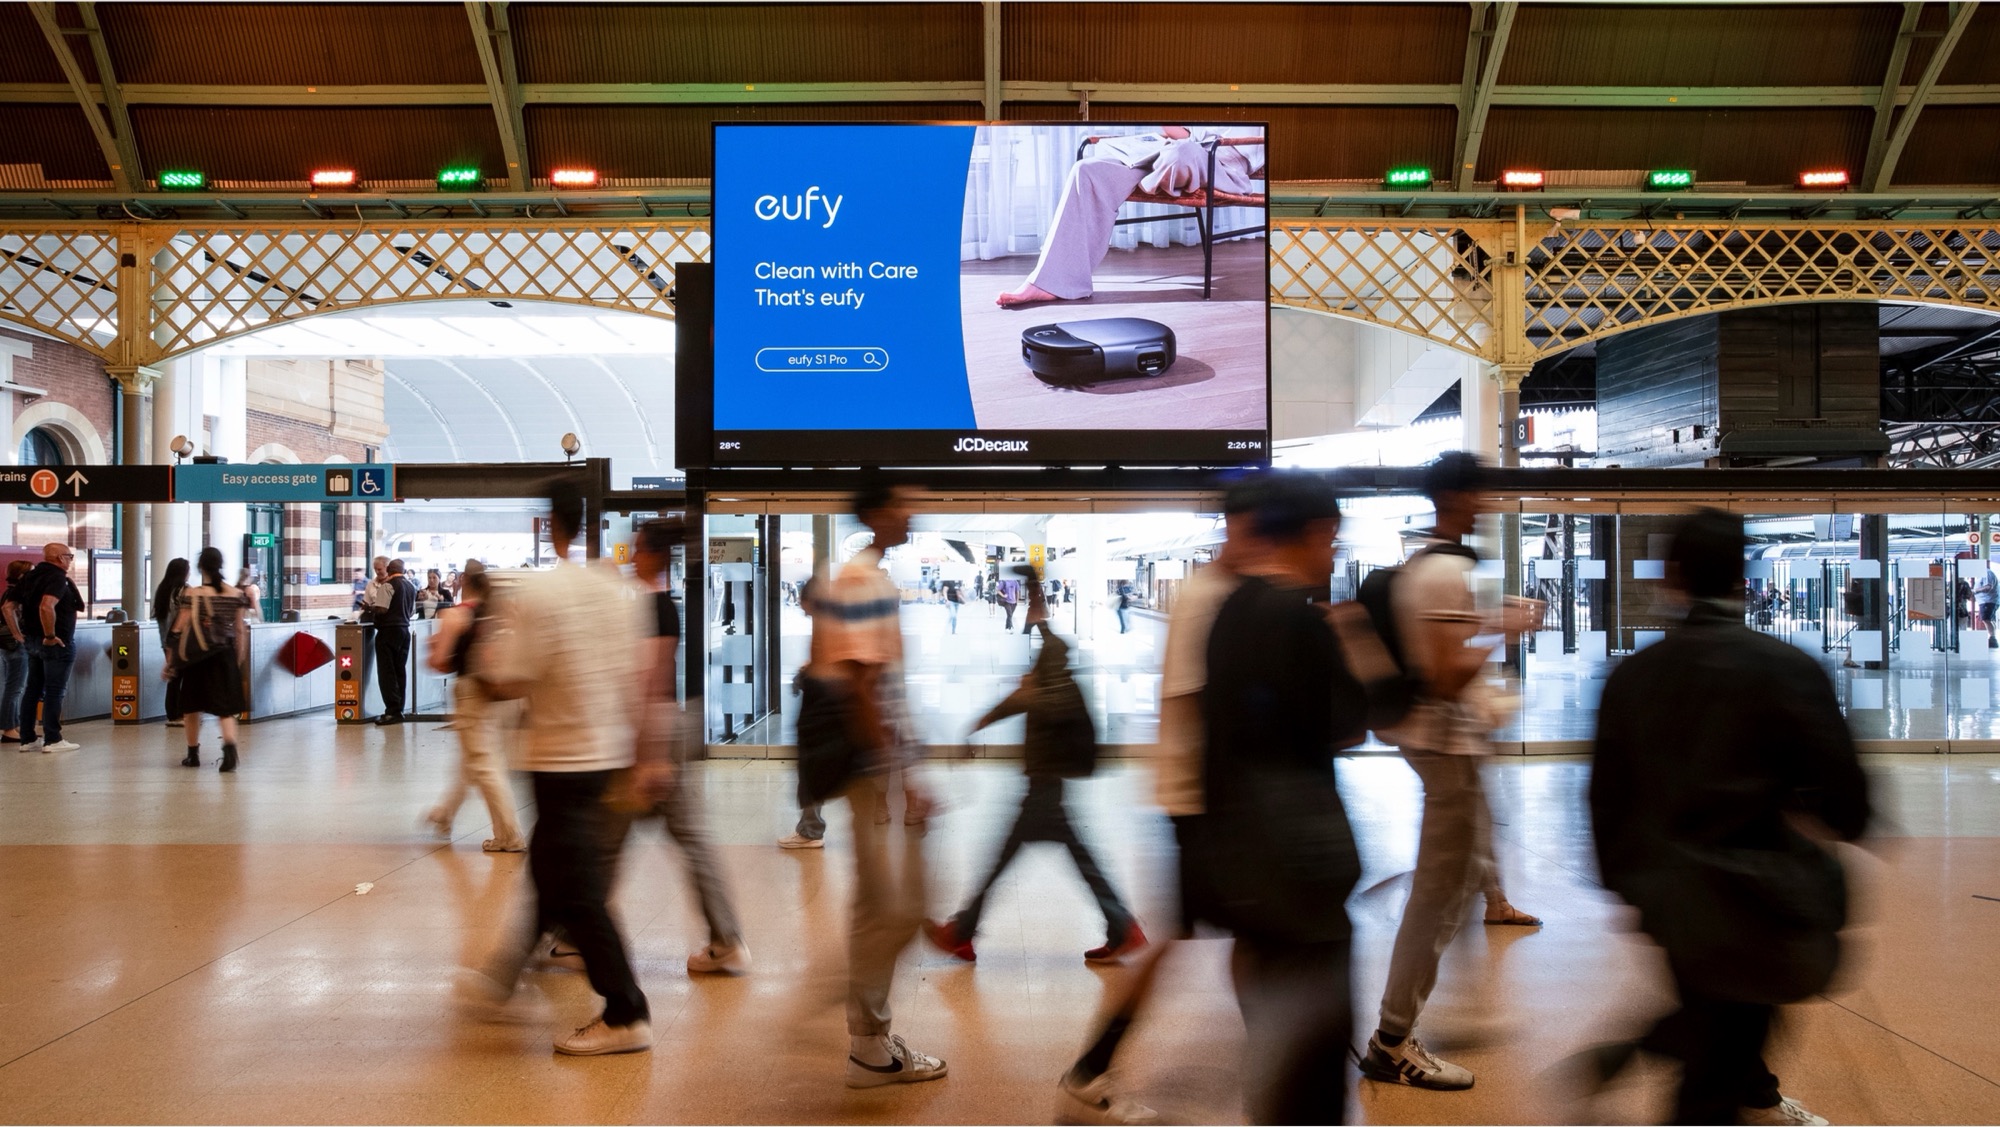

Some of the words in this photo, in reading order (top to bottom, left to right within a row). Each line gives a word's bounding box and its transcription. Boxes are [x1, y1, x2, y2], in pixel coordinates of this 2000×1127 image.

[754, 186, 843, 228] eufy
[754, 262, 815, 279] Clean
[821, 262, 863, 279] with
[868, 262, 919, 279] Care
[754, 289, 815, 306] That's
[820, 288, 865, 309] eufy
[788, 354, 813, 367] eufy
[815, 354, 827, 365] S1
[829, 354, 848, 365] Pro
[1518, 424, 1526, 440] 8
[719, 441, 741, 450] 28°C
[953, 437, 1029, 452] JCDecaux
[1227, 441, 1247, 449] 2:26
[1248, 441, 1262, 449] PM
[0, 471, 27, 482] rains
[38, 476, 51, 492] T
[222, 473, 249, 487] Easy
[250, 474, 290, 484] access
[291, 474, 318, 486] gate
